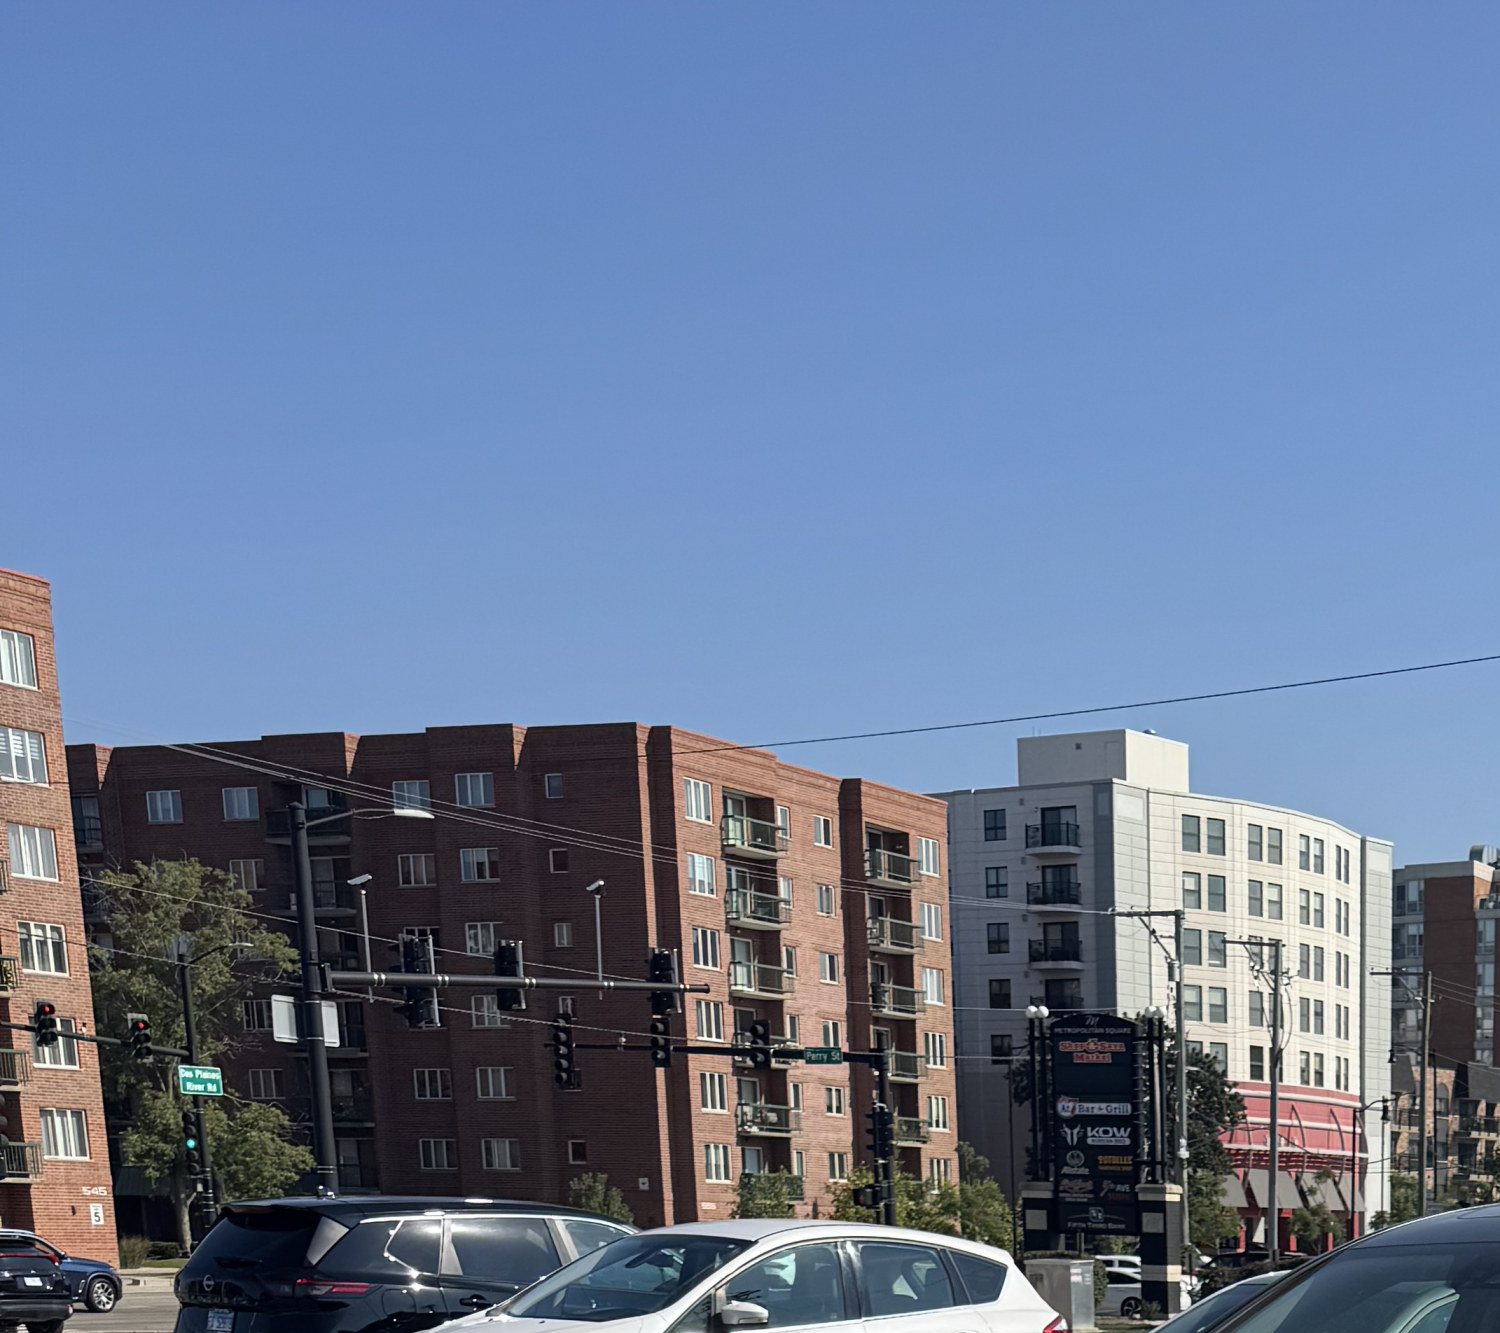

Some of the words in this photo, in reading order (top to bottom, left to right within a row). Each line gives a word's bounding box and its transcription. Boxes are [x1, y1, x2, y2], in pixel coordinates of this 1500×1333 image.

[1077, 1104, 1096, 1113] Bar
[1105, 1104, 1129, 1113] Grill
[1086, 1126, 1131, 1138] KOW
[82, 1186, 107, 1196] 545
[94, 1211, 101, 1222] 5
